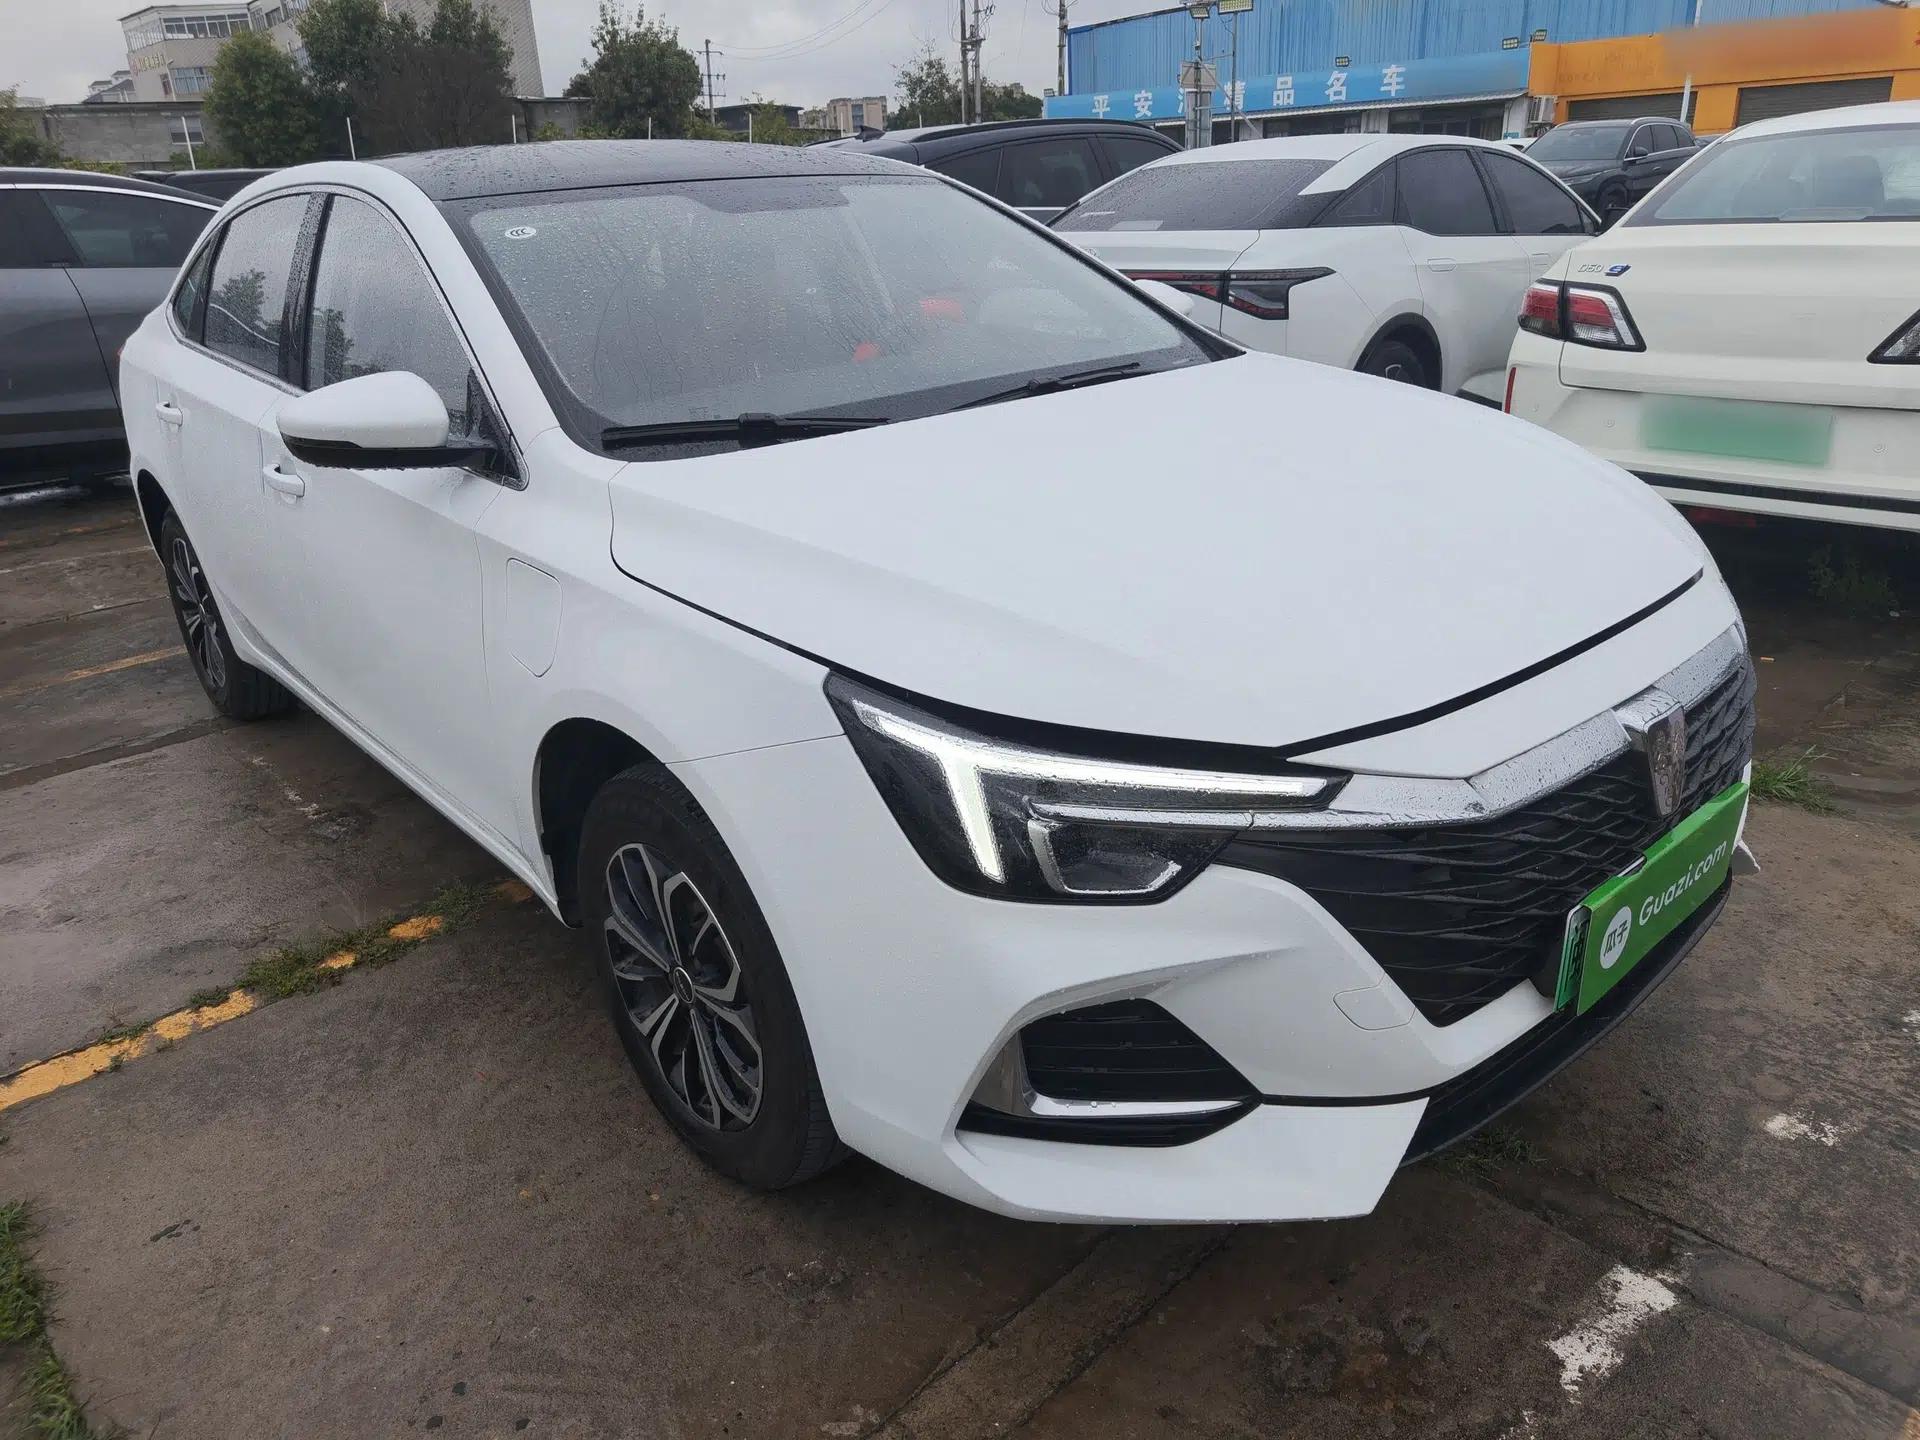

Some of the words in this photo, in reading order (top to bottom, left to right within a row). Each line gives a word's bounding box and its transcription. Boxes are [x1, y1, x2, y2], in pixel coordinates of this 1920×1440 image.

[1091, 64, 1406, 119] 平安精品名车
[1639, 840, 1727, 926] Guazi.com
[1603, 919, 1629, 958] 瓜子
